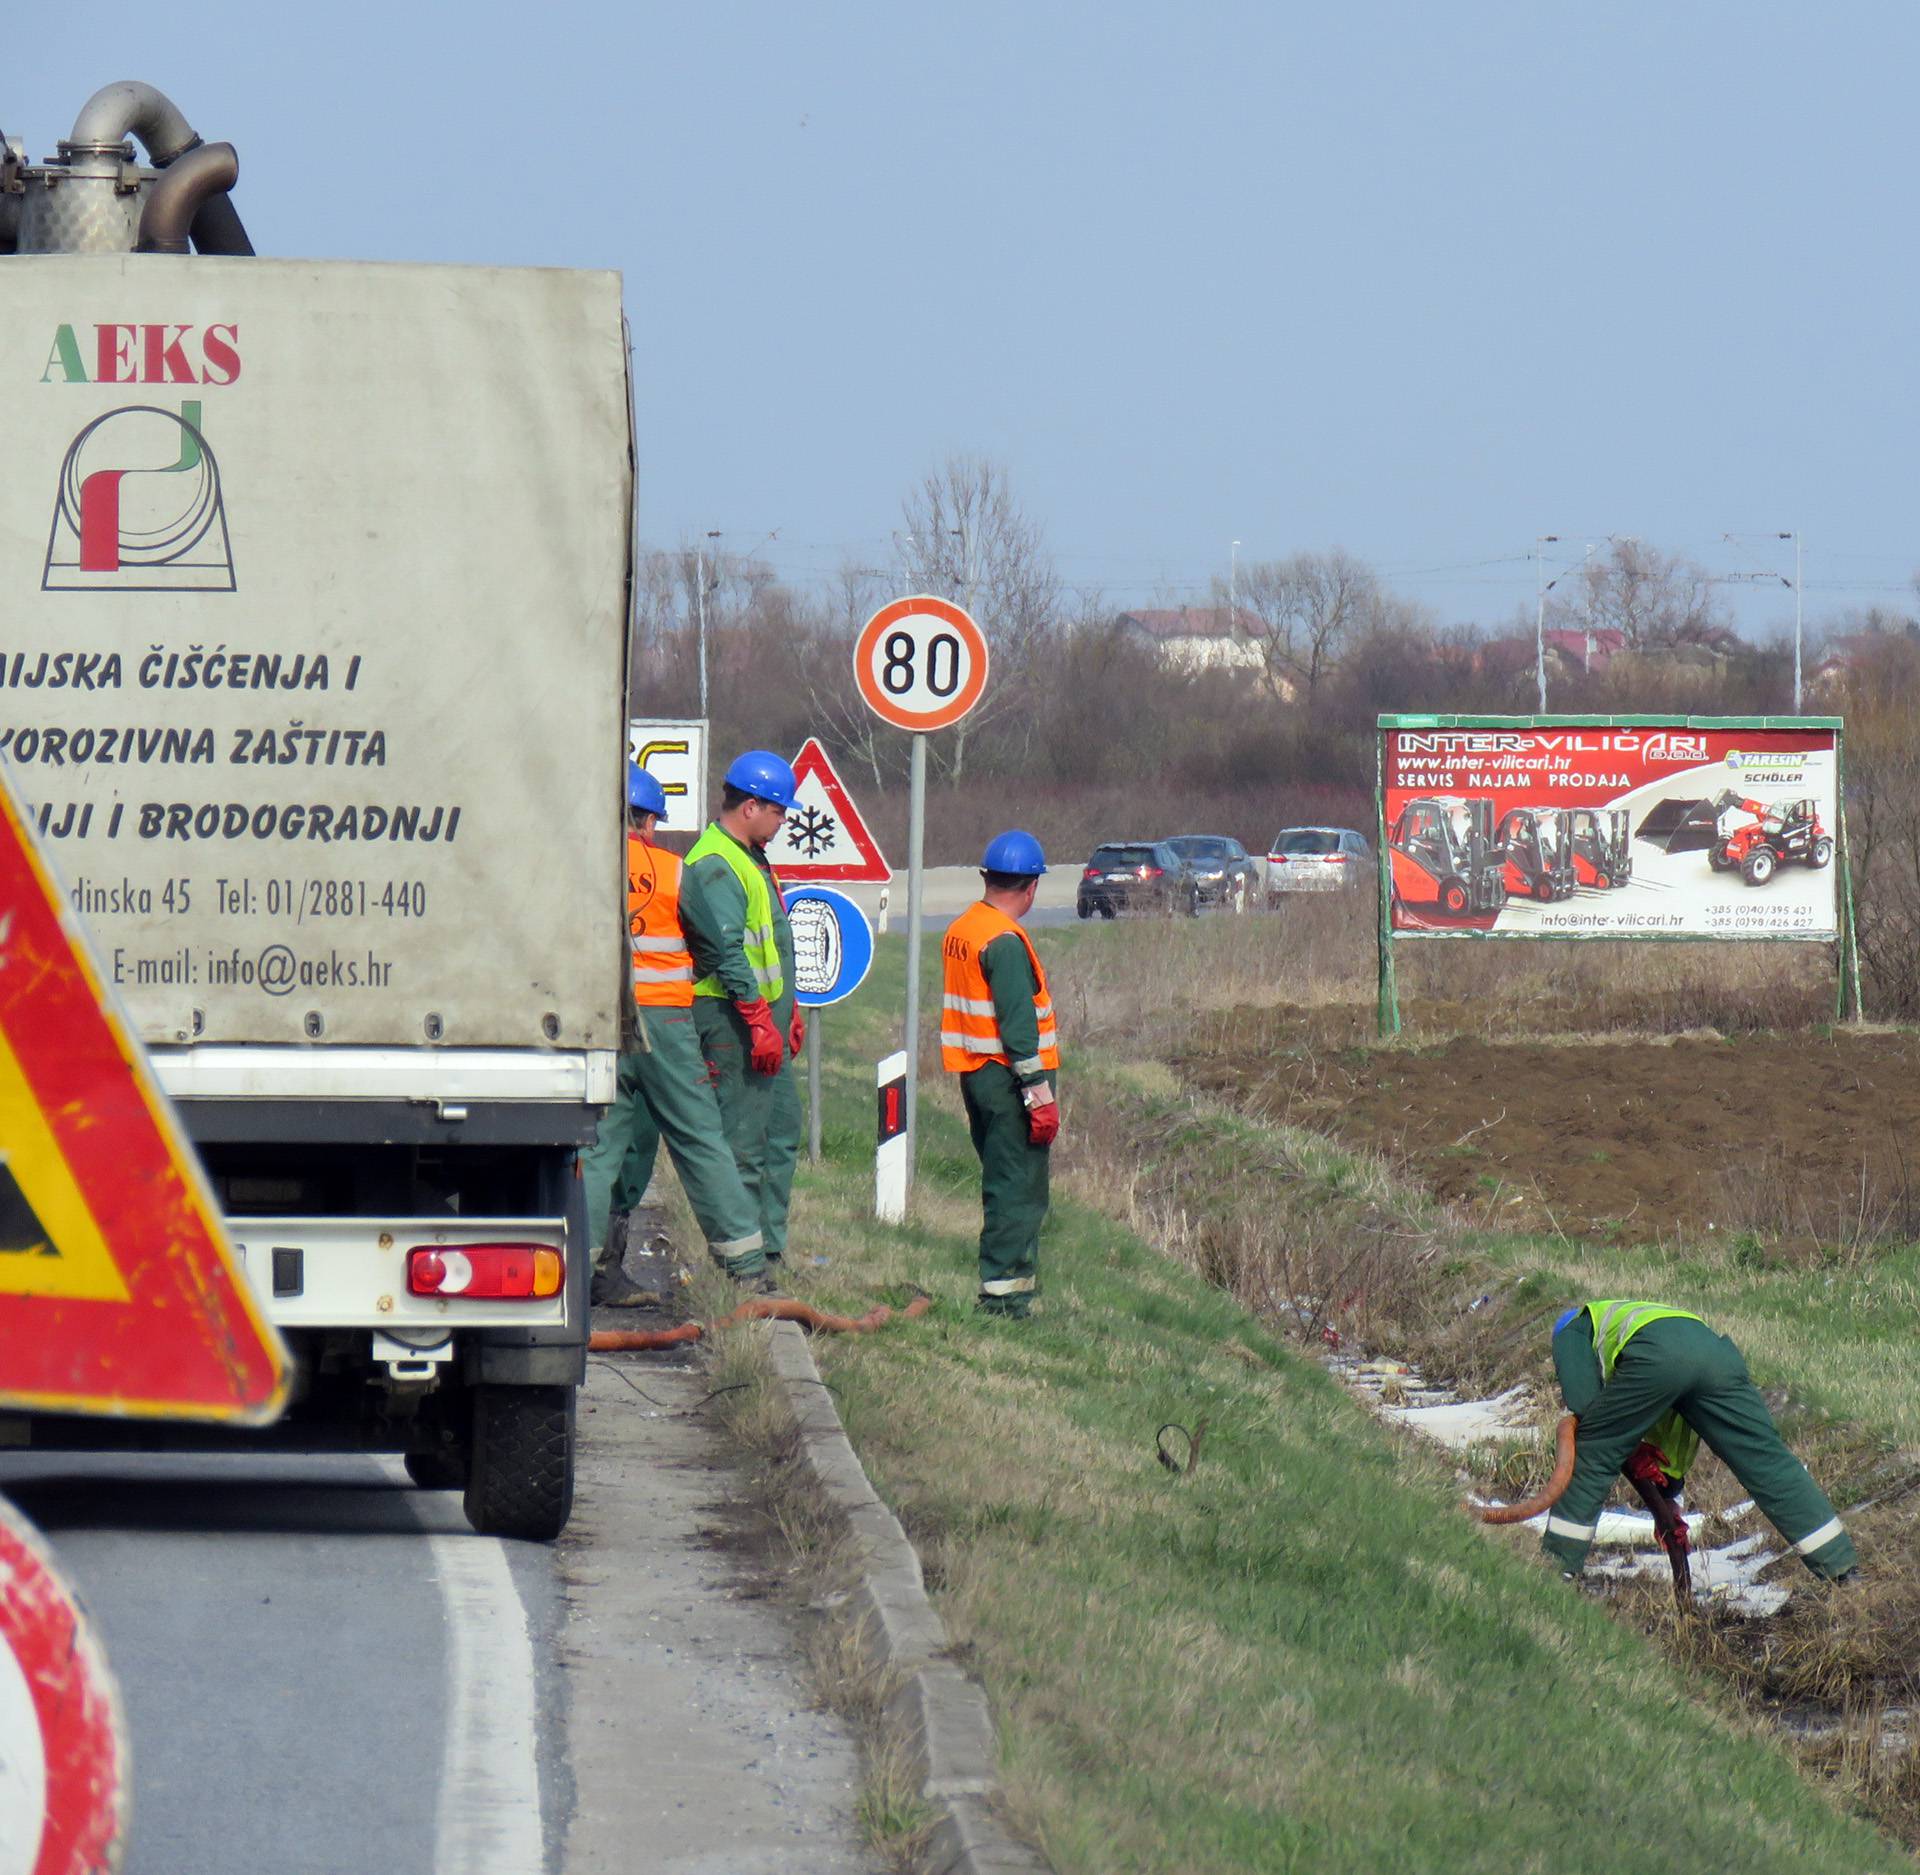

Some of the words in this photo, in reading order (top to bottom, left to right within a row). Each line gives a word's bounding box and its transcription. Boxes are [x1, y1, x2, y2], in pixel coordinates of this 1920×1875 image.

[39, 324, 241, 386] AEKS
[138, 645, 329, 691] ČIŠĆENJA
[345, 656, 361, 691] I
[882, 631, 960, 697] 80
[230, 720, 387, 767] ZAŠTITA
[1397, 755, 1571, 770] www.inter-vilicari.hr
[1398, 728, 1707, 767] INTER-VILIČARI
[1743, 755, 1802, 766] FARESIN
[1398, 774, 1454, 787] SERVIS
[1469, 774, 1531, 787] NAJAM
[1549, 774, 1631, 787] PRODAJA
[107, 803, 124, 839] I
[139, 804, 461, 843] BRODOGRADNJI
[162, 878, 190, 914] 45
[216, 878, 257, 915] Tel:
[266, 879, 426, 924] 01/2881-440
[1541, 913, 1684, 926] info@inter-vilicari.hr
[1705, 905, 1732, 915] +385
[1793, 906, 1812, 915] 431
[114, 948, 198, 984] E-mail:
[208, 944, 392, 995] info@aeks.hr
